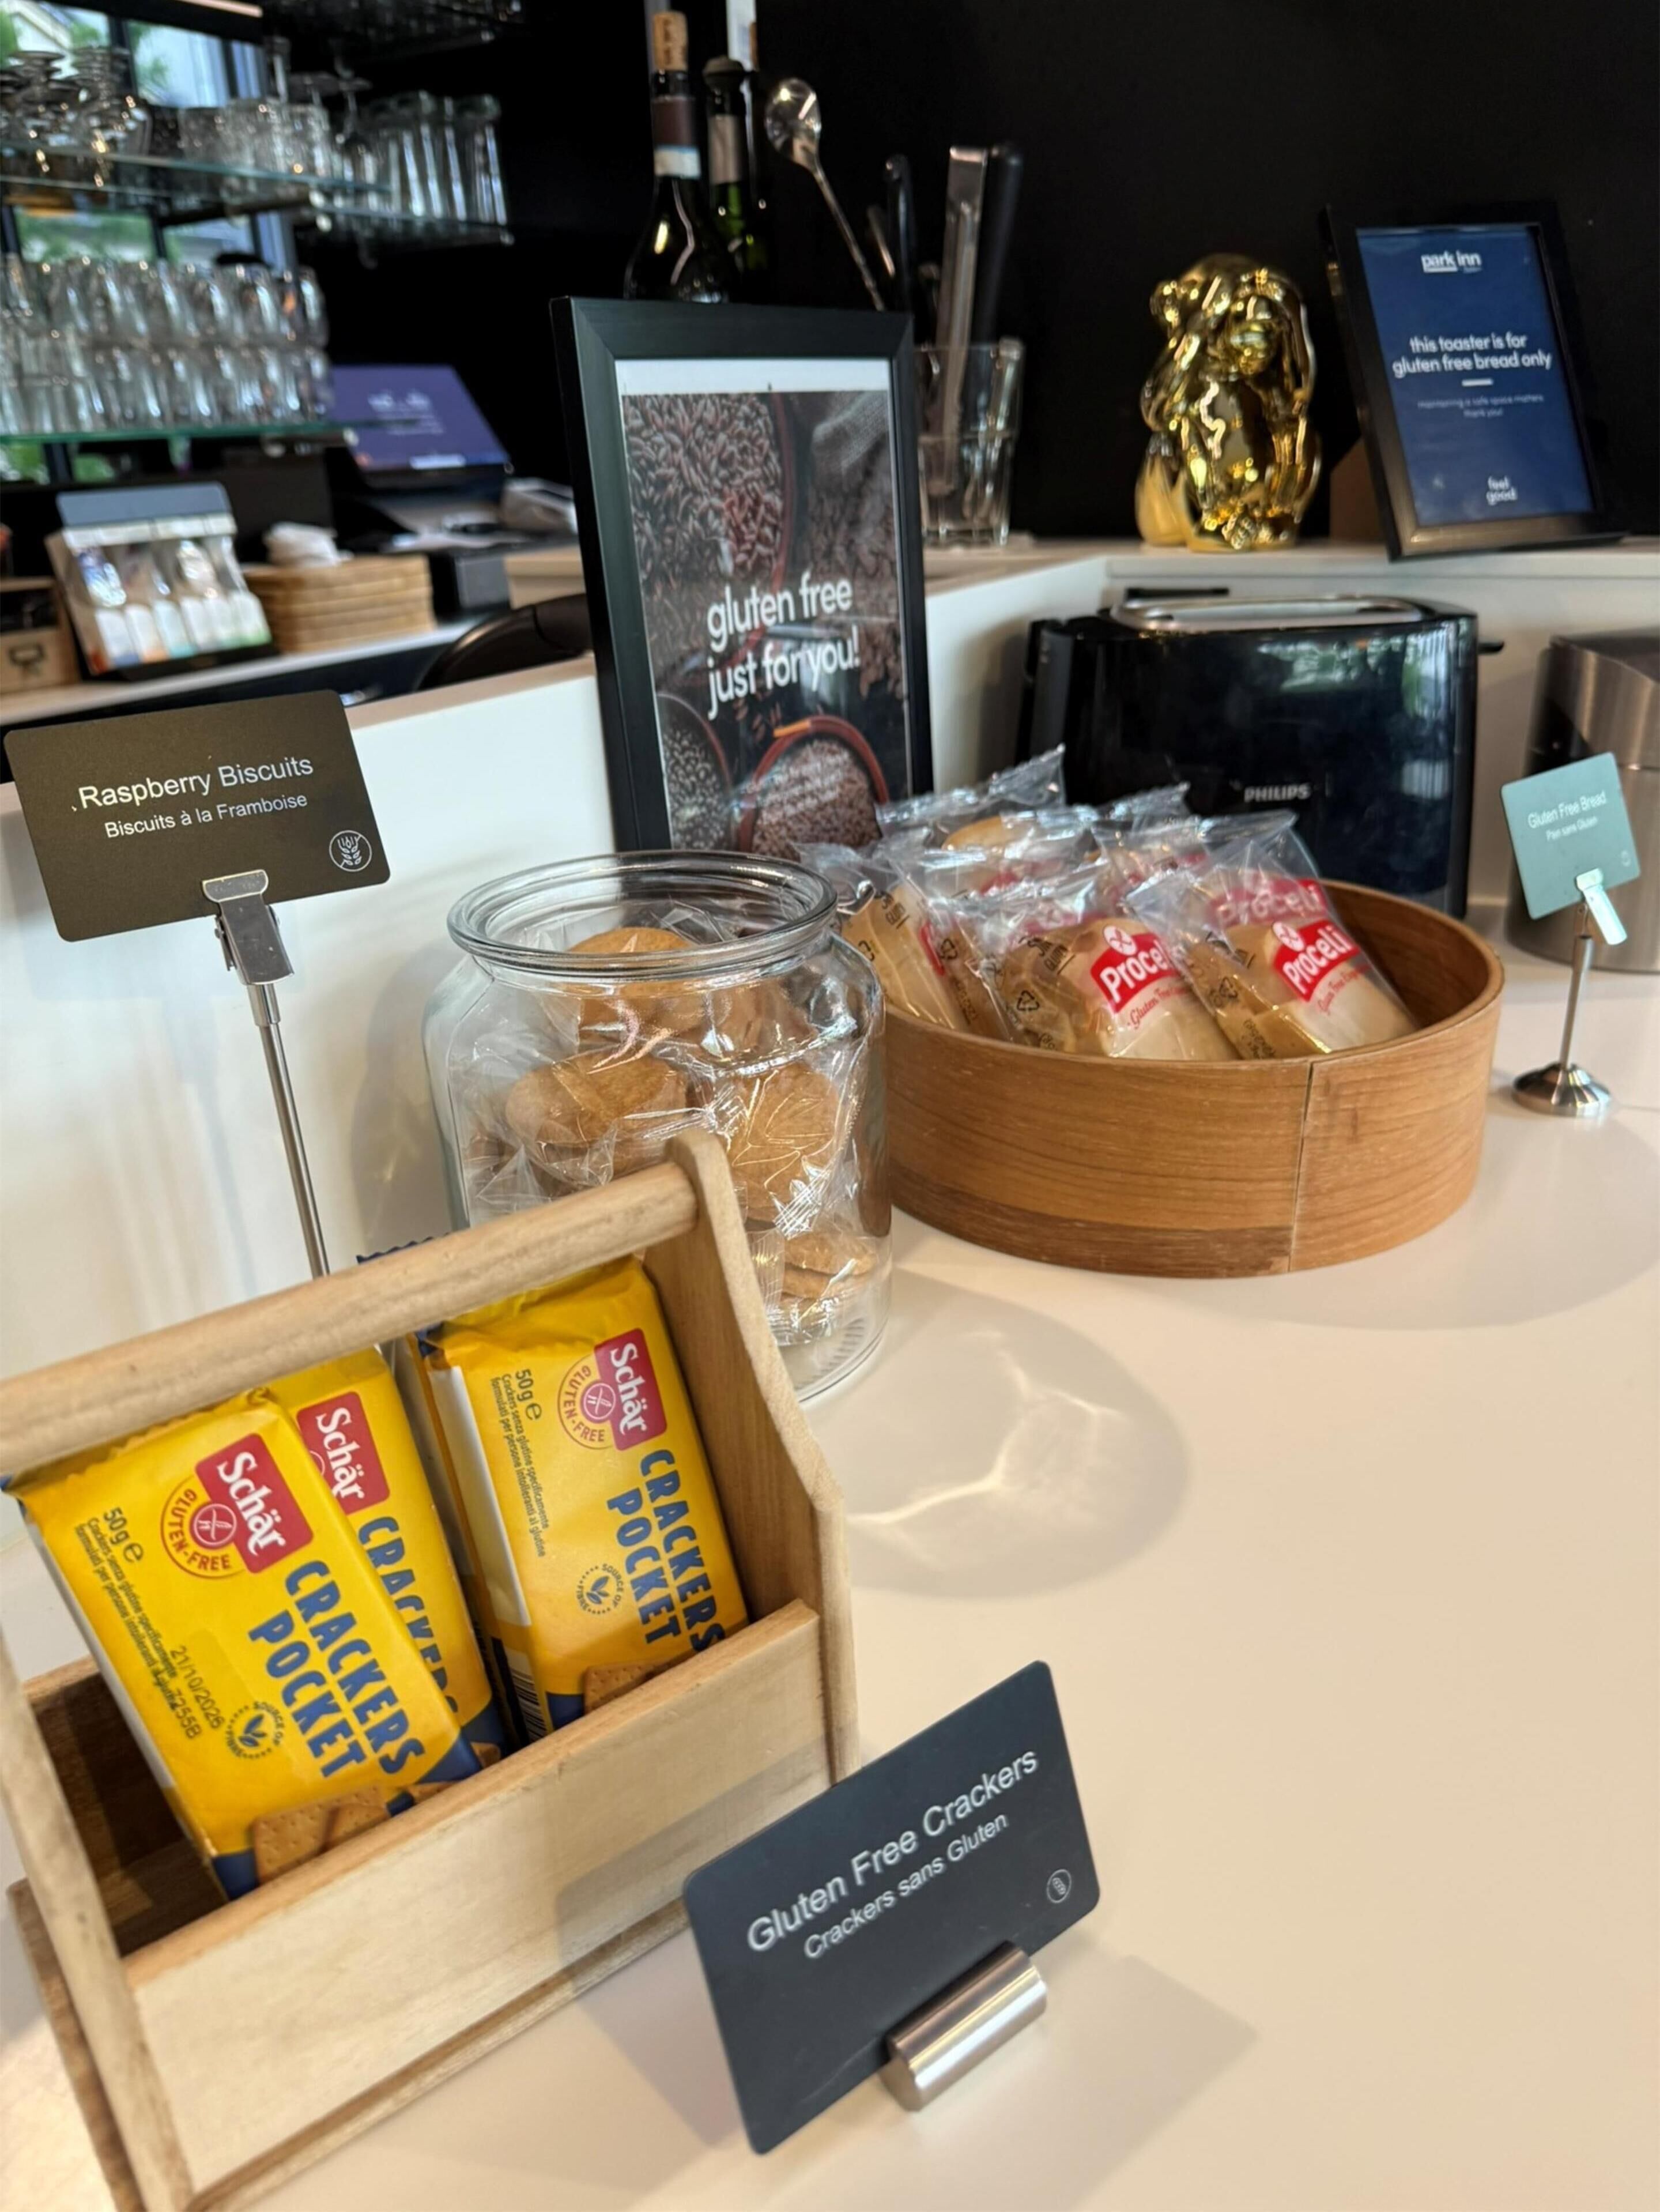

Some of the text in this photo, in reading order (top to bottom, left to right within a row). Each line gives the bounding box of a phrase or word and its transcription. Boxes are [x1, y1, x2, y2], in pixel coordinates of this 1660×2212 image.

[1421, 249, 1482, 273] park inn
[1392, 348, 1552, 379] gluten free bread only
[1409, 331, 1527, 353] this toaster is for
[1486, 487, 1518, 506] good
[1488, 475, 1510, 490] feel
[707, 571, 852, 653] gluten free
[707, 624, 861, 721] just for you!
[78, 757, 314, 809] Raspberry Biscuits
[104, 793, 307, 838] Biscuits à la Framboise
[1244, 783, 1311, 802] PHILIPS
[1528, 789, 1606, 828] Gluten Free Bread
[1561, 824, 1577, 836] sans
[1577, 816, 1598, 830] Gluten
[1100, 939, 1168, 1004] Procel
[1282, 924, 1354, 995] Proceli
[1129, 996, 1159, 1029] Gluten
[515, 1369, 534, 1389] 50
[516, 1390, 533, 1402] g
[563, 1365, 605, 1442] GLUTEN-FREE
[610, 1343, 648, 1435] Schär
[316, 1407, 365, 1500] Schär
[491, 1377, 546, 1557] formulati per persone intolleranti al glutine
[501, 1374, 549, 1529] Crackers senza glutine specificamente
[103, 1507, 127, 1531] 50
[168, 1488, 232, 1571] GLUTEN-FREE
[217, 1452, 286, 1556] Schär
[110, 1531, 130, 1546] g
[606, 1487, 681, 1644] POCKET
[640, 1449, 726, 1652] CRACKERS
[601, 1563, 624, 1592] SOURCE
[171, 1646, 224, 1729] 21/10/2026
[248, 1608, 367, 1778] POCKET
[285, 1559, 425, 1774] CRACKERS
[748, 1750, 1038, 1952] Gluten Free Crackers
[804, 1812, 1010, 1958] Crackers sans Gluten
